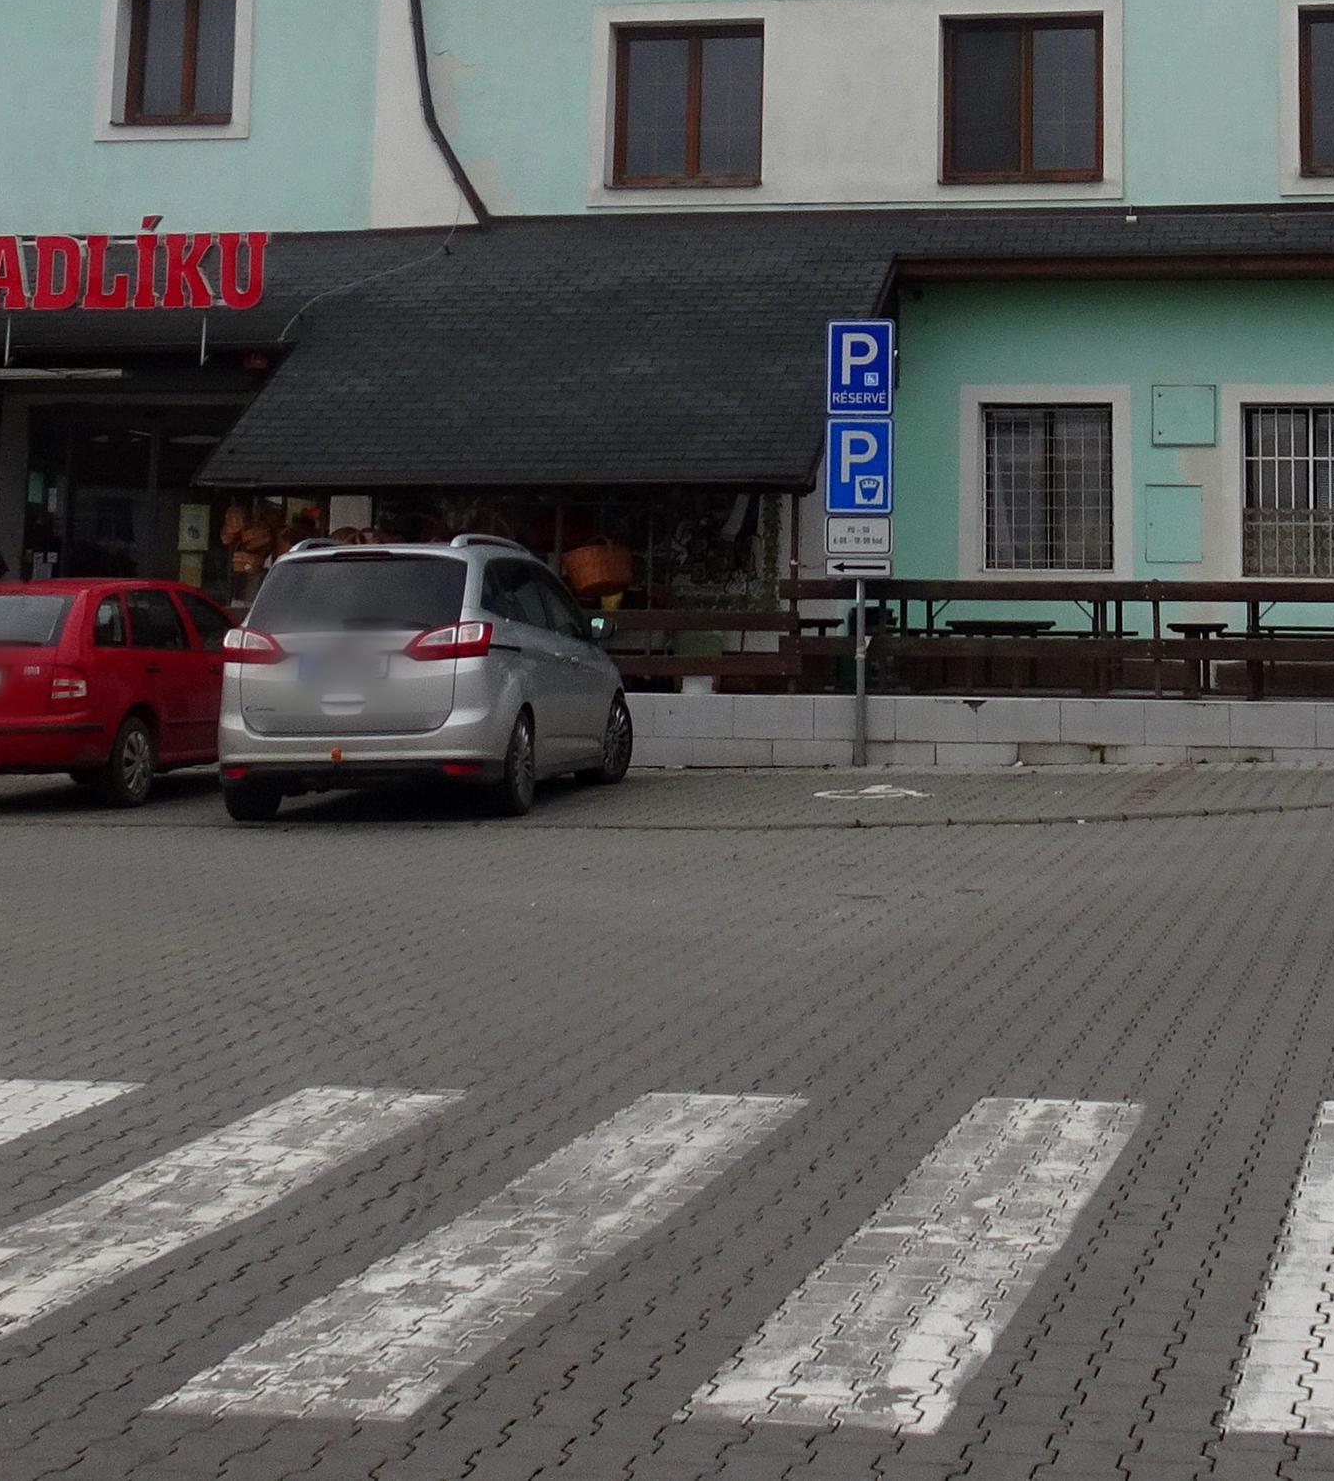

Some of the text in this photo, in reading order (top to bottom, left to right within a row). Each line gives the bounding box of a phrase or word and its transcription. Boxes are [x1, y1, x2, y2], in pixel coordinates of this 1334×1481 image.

[841, 333, 878, 385] P
[832, 390, 887, 404] RÉSERVÉ
[840, 430, 878, 483] P
